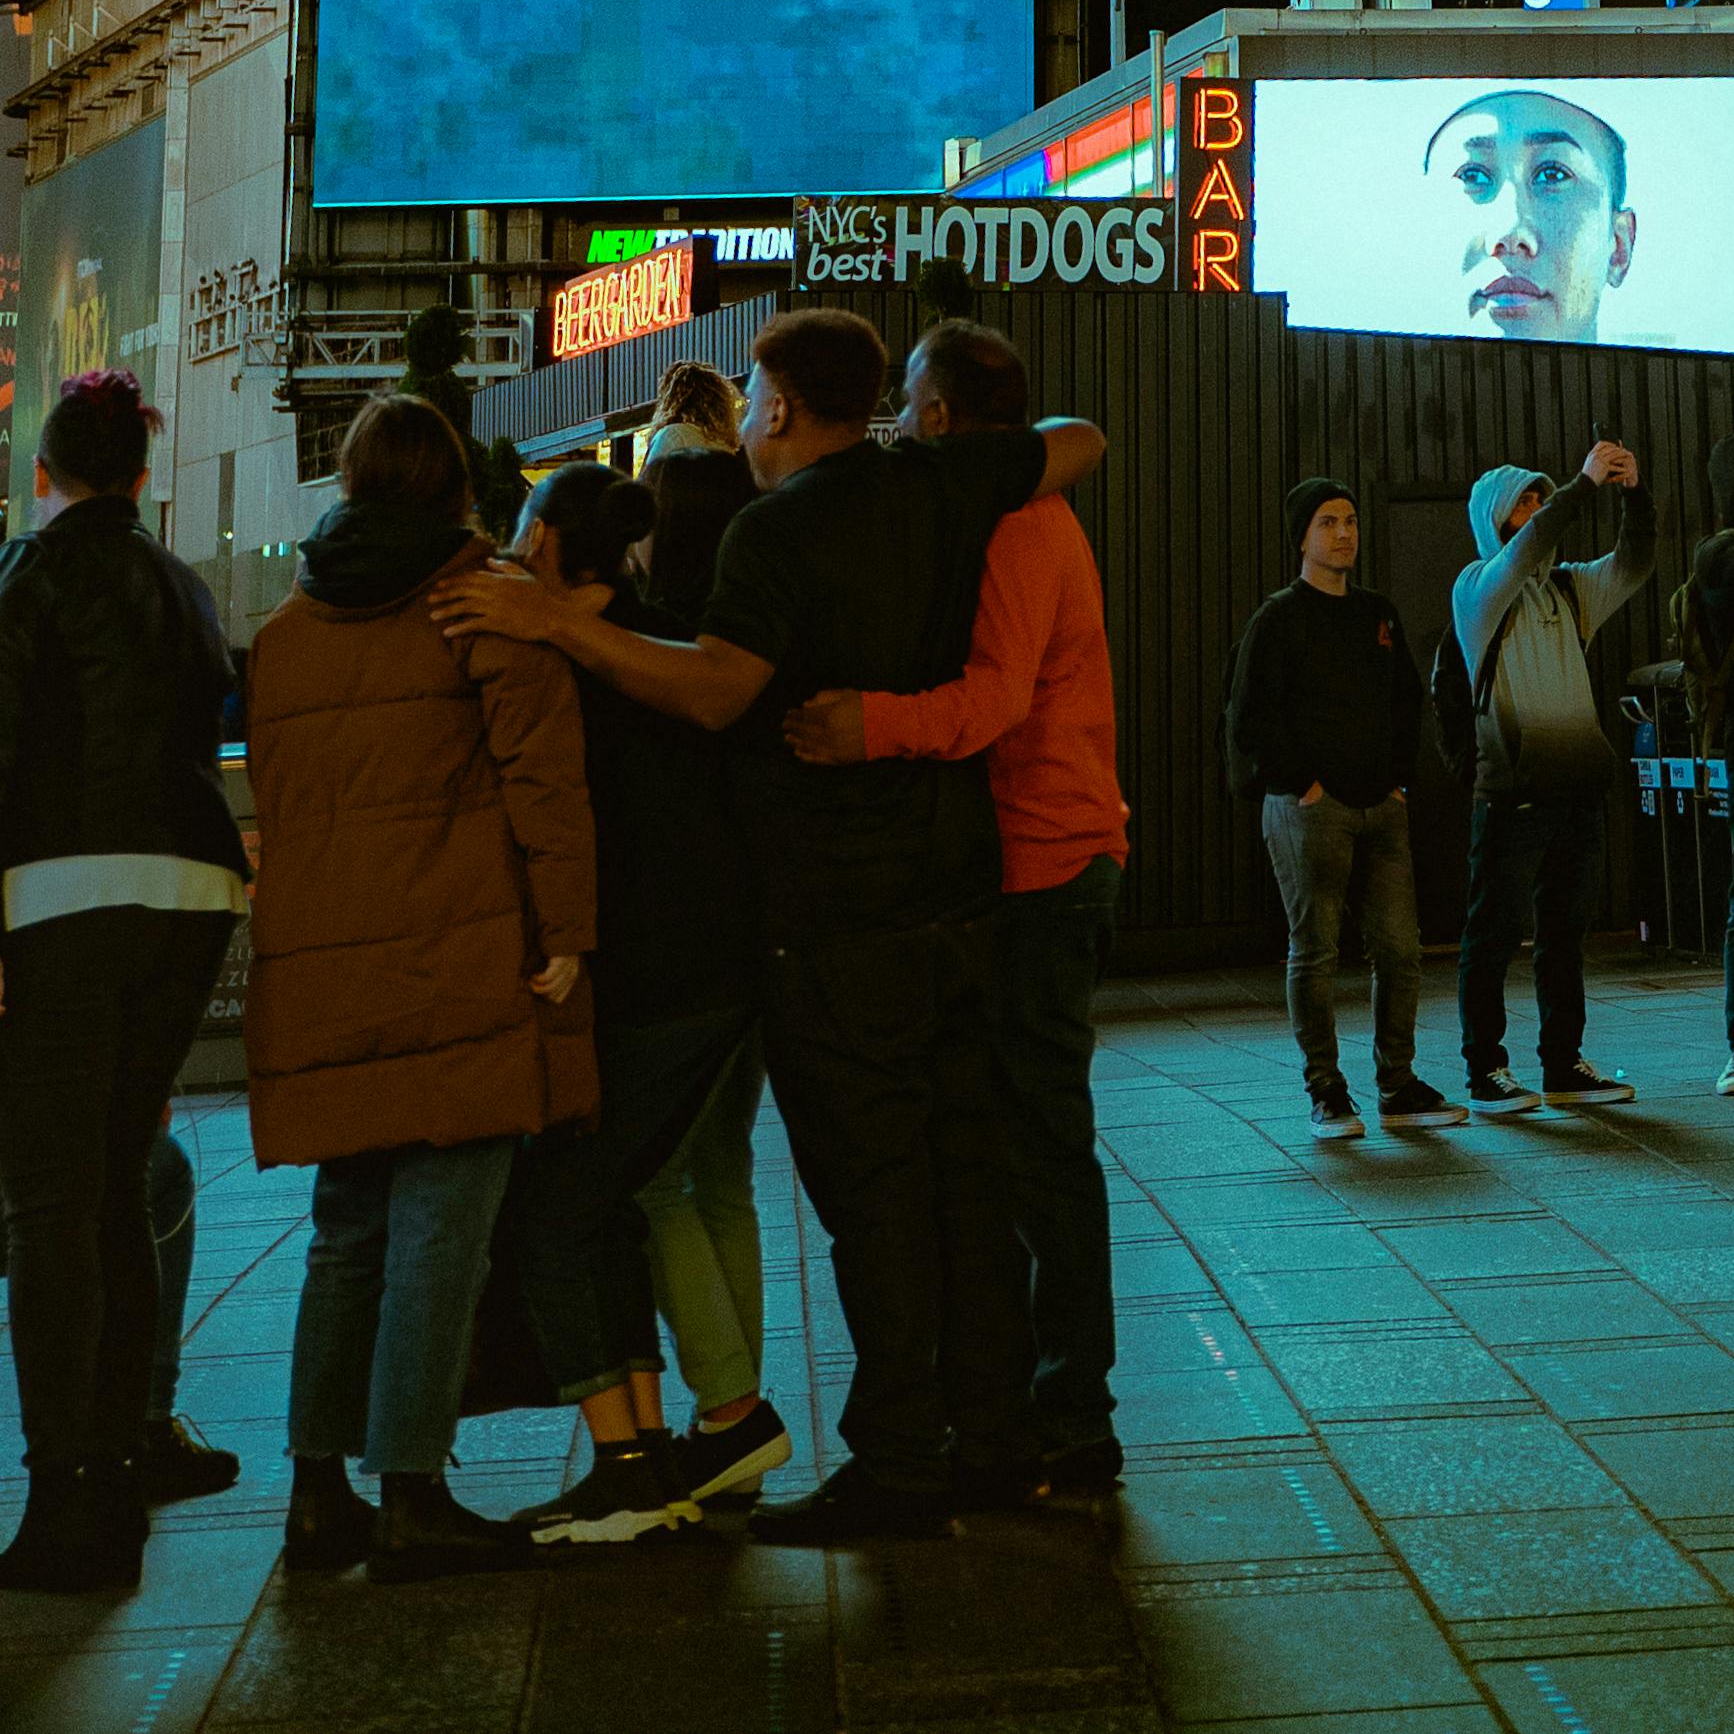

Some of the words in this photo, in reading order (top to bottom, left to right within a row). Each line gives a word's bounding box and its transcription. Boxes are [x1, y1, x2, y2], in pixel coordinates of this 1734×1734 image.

[1191, 86, 1246, 295] BAR
[806, 243, 884, 282] best
[807, 205, 888, 246] NYC's
[894, 205, 1166, 285] HOTDOGS
[552, 248, 685, 358] BEERGARDEN
